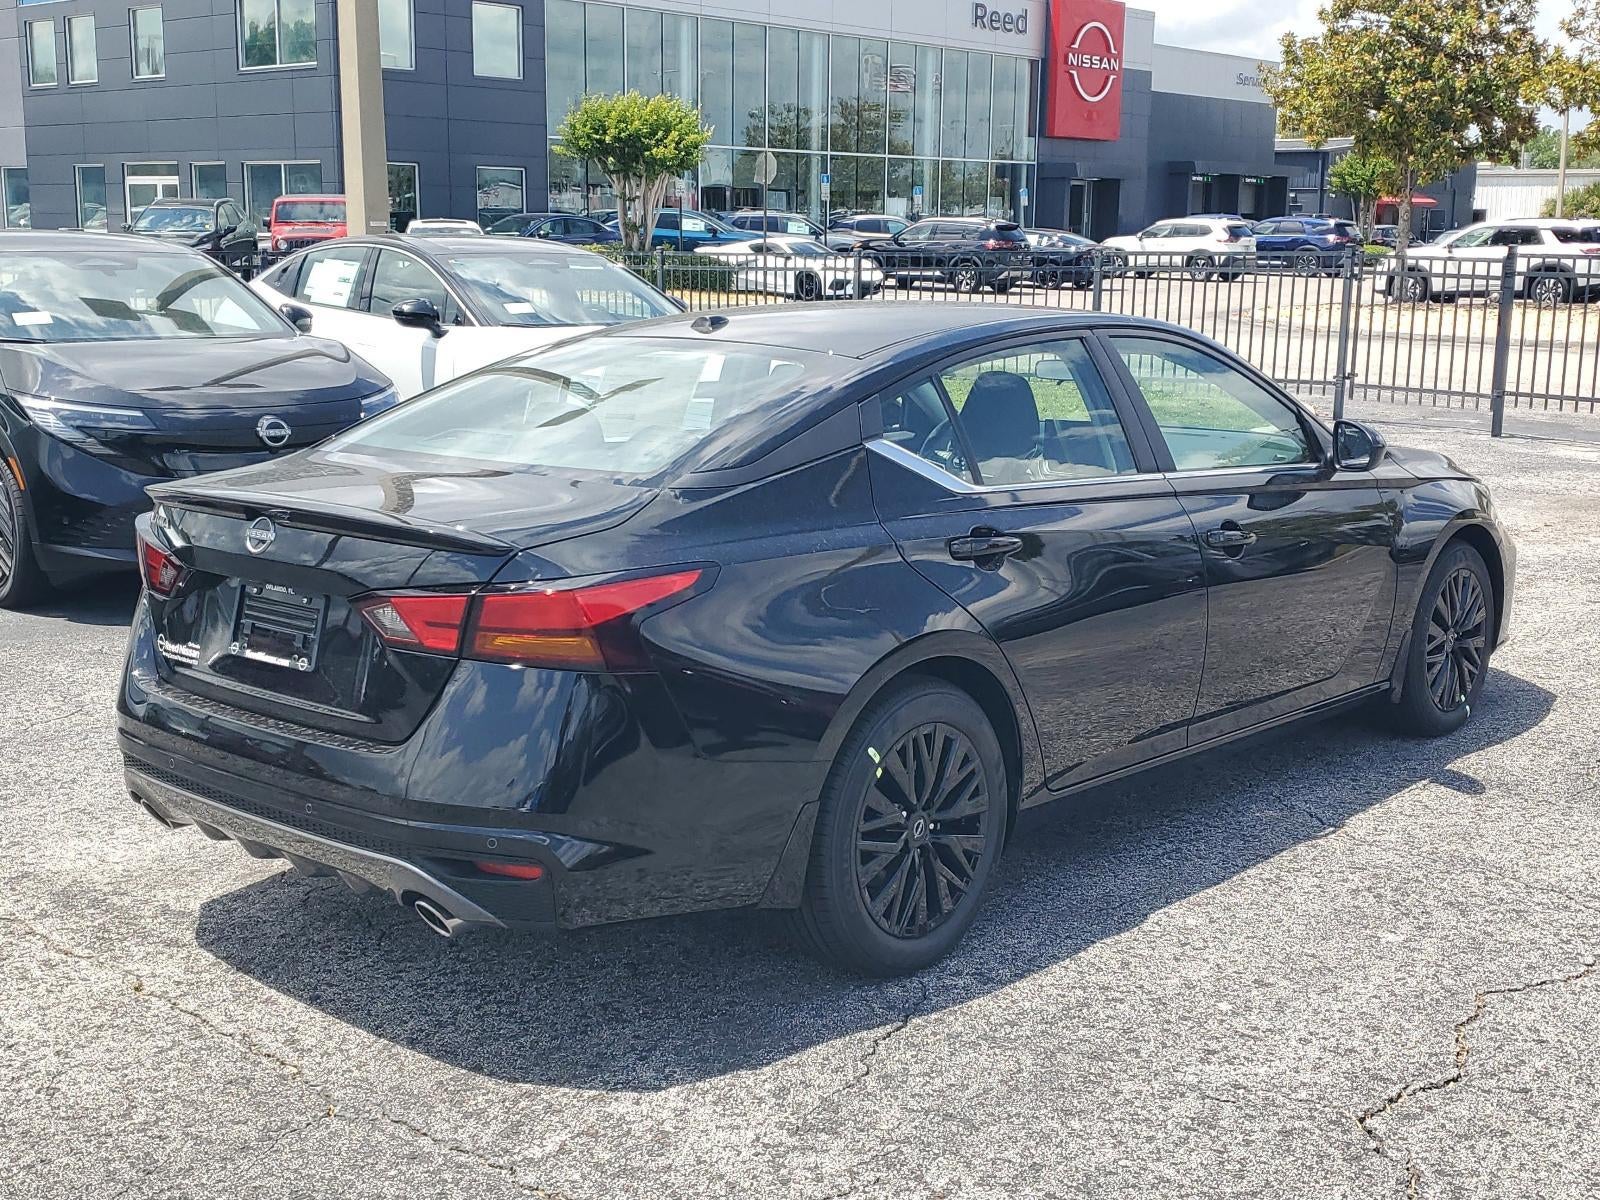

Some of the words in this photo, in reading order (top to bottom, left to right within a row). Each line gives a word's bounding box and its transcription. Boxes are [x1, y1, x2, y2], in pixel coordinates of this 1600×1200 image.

[973, 3, 1028, 34] Reed
[1068, 53, 1119, 71] NISSAN
[258, 428, 292, 437] NISSAN
